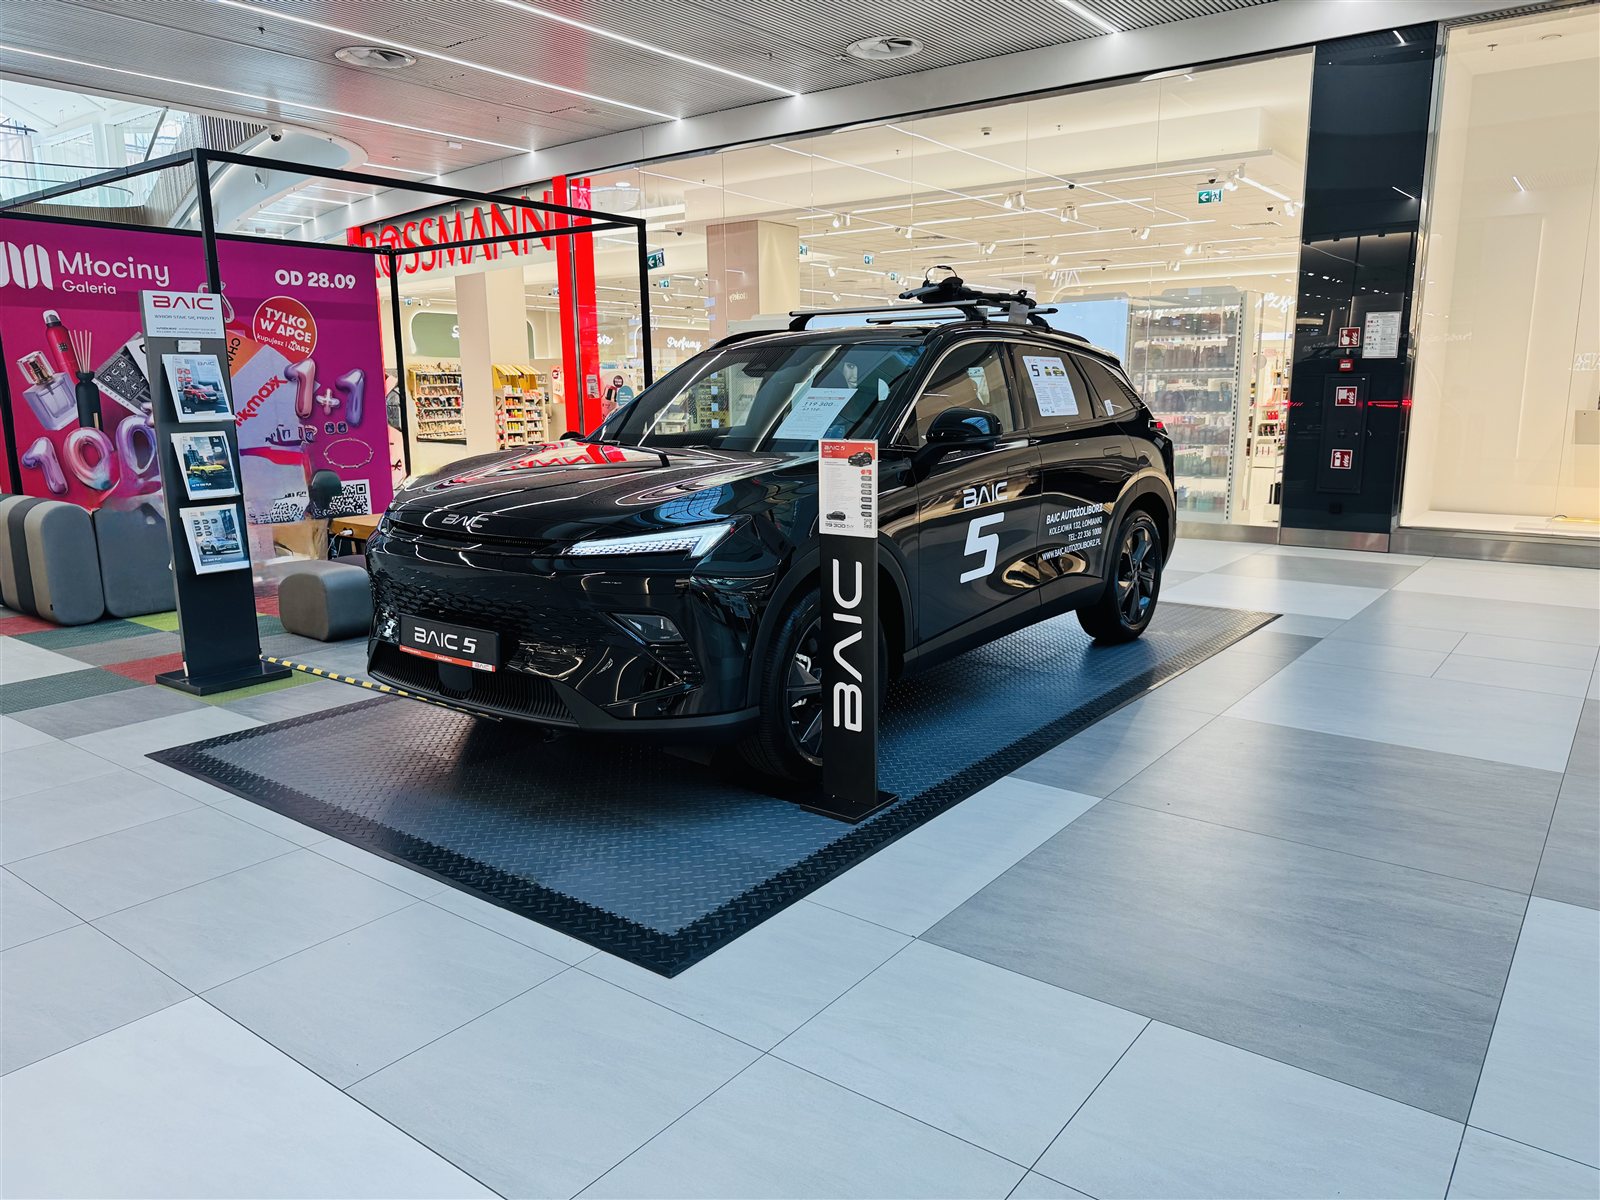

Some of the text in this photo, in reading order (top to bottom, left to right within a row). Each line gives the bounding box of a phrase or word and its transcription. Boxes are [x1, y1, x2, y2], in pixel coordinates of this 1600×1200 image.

[57, 250, 170, 287] Młociny
[275, 269, 356, 290] OD 28.09
[62, 279, 117, 295] Galeria
[152, 295, 214, 311] BAIC
[265, 307, 307, 329] TYLKO
[257, 332, 284, 347] kupujesz
[260, 318, 312, 344] W APCE
[666, 336, 702, 351] Perfumy
[1031, 364, 1040, 377] 5
[963, 481, 1008, 508] BAIC
[442, 514, 489, 529] BAIC
[1046, 503, 1103, 525] BAIC AUTOŻOLIBORZ
[959, 512, 1005, 584] 5
[414, 626, 478, 654] BAIC 5
[832, 558, 862, 733] BAIC
